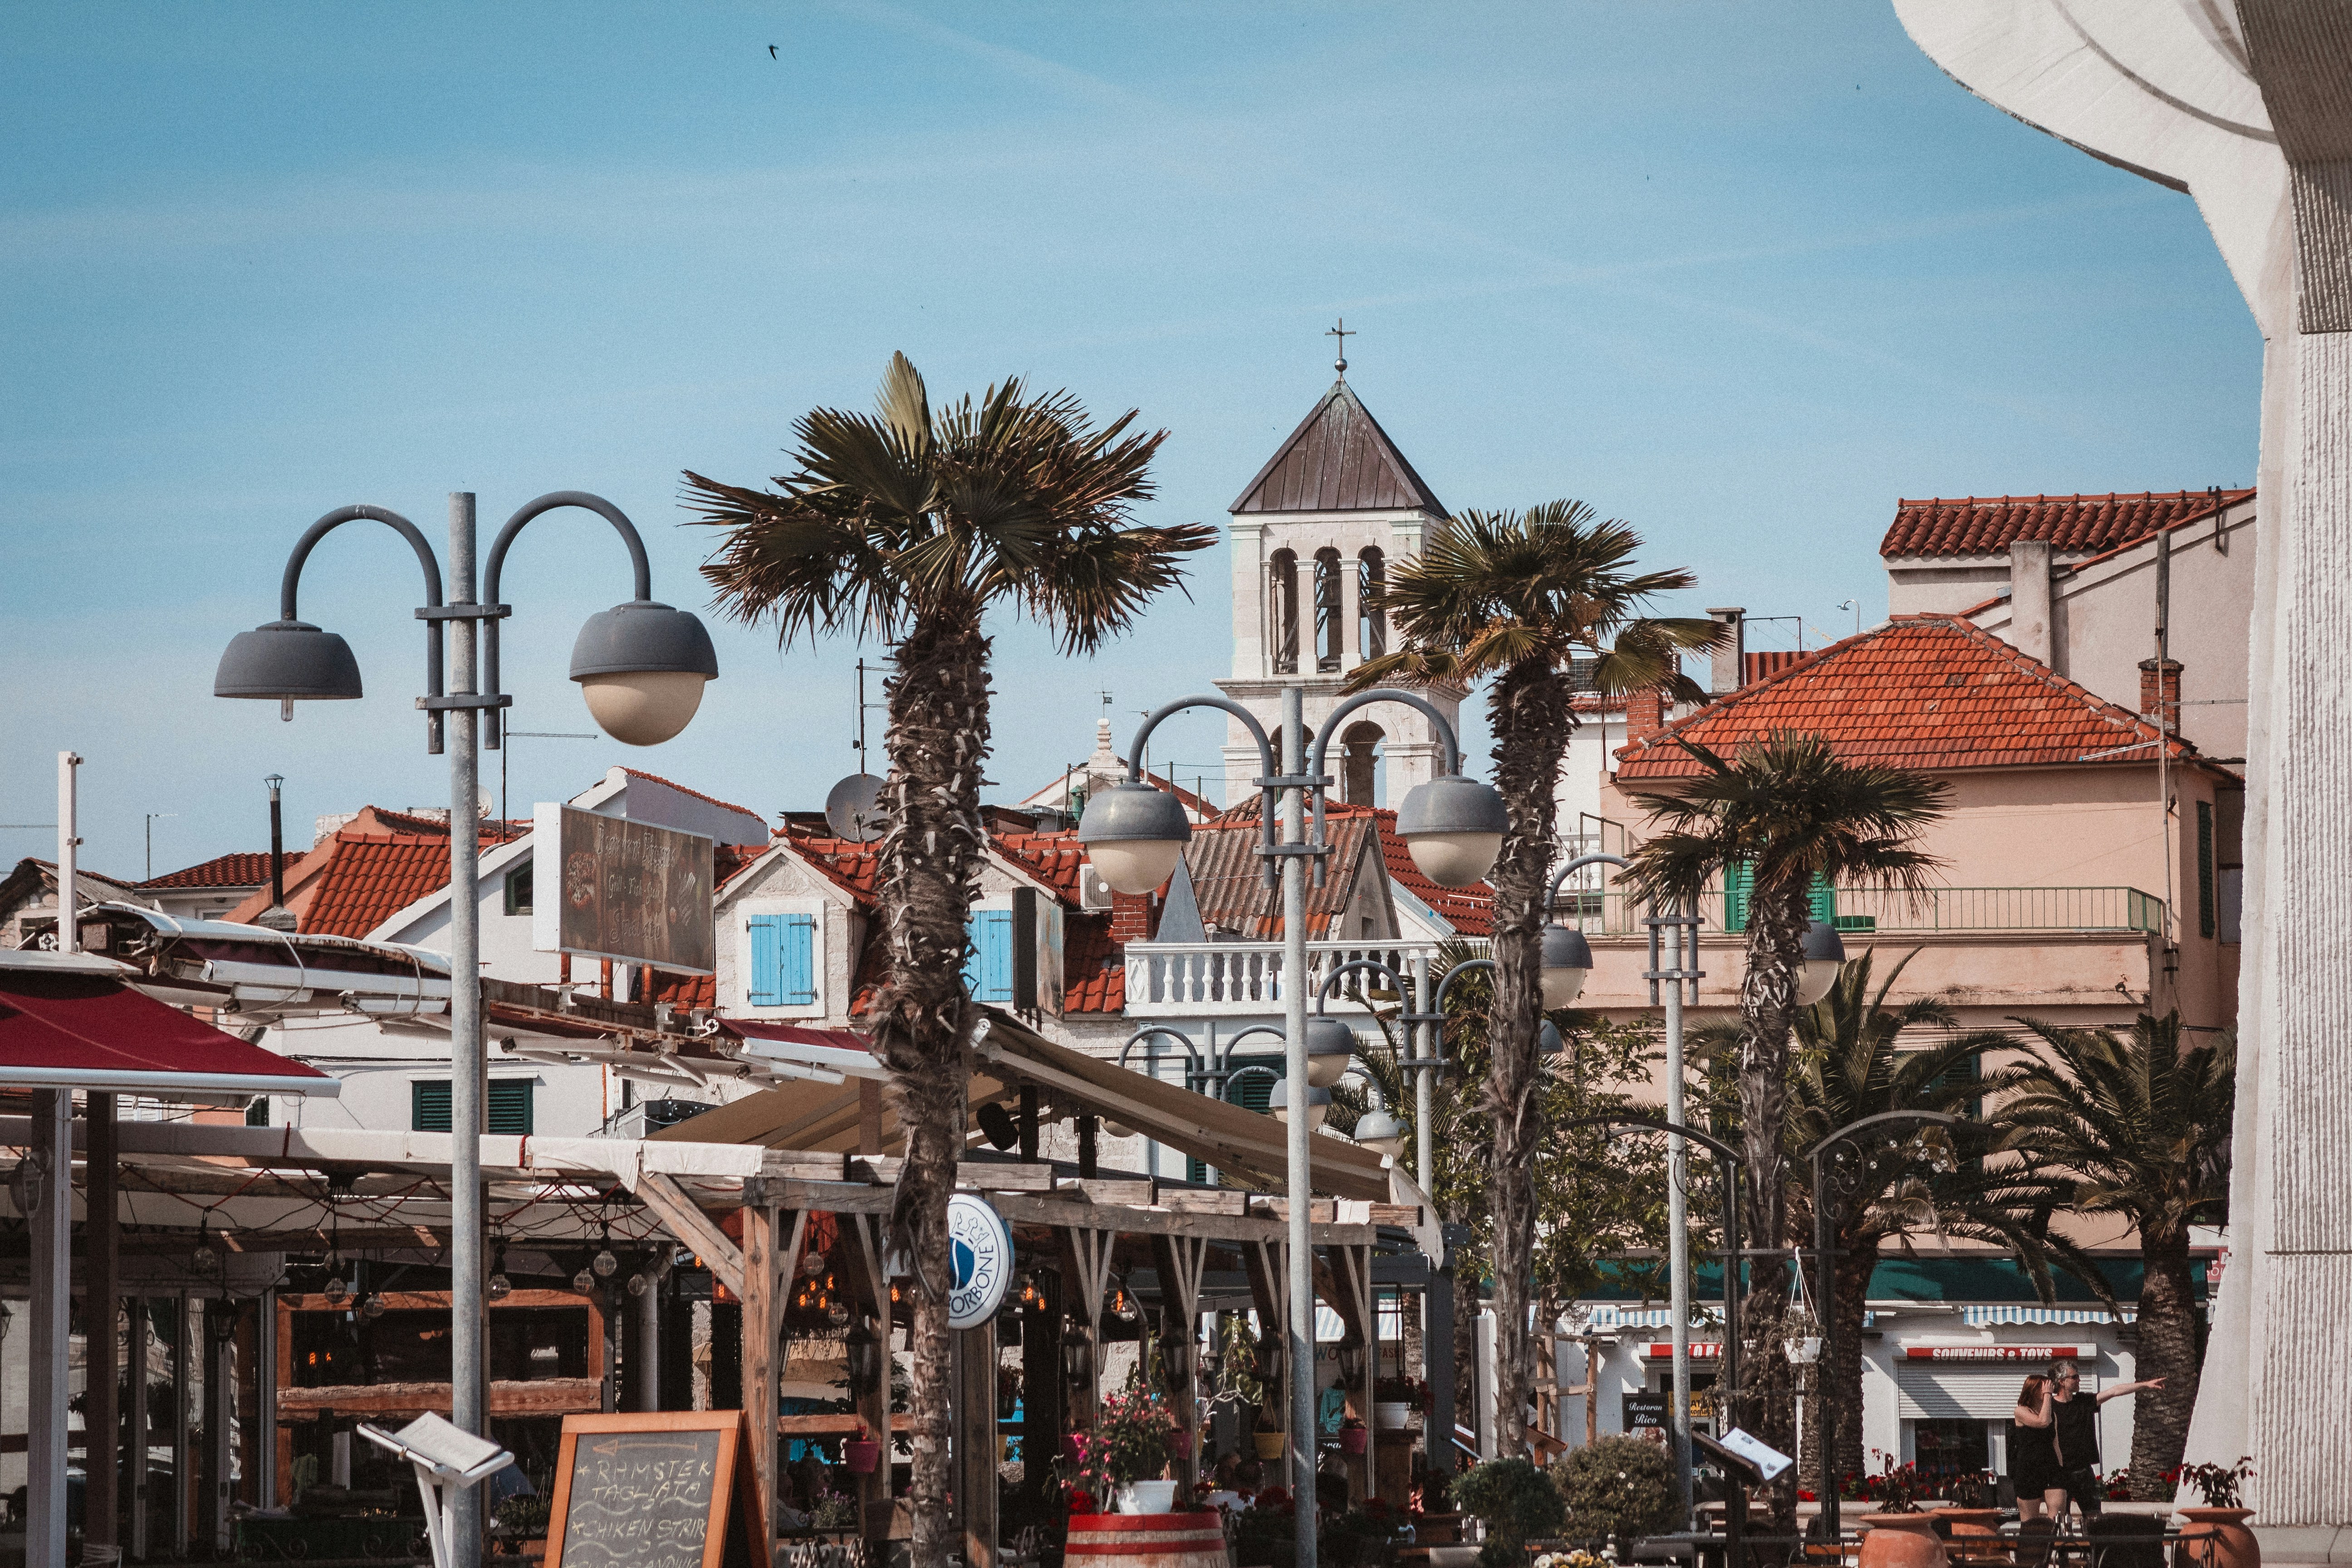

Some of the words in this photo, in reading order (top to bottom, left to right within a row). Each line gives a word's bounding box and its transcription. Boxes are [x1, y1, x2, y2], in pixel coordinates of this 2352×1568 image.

[608, 874, 622, 899] Grill
[949, 1245, 994, 1313] ORBONE
[1932, 1348, 2005, 1361] SOUVENIRS
[2020, 1348, 2053, 1360] TOYS
[1629, 1402, 1662, 1411] Restoran
[1635, 1413, 1656, 1424] Rico
[592, 1480, 701, 1501] TAGLIATA
[583, 1519, 653, 1539] CHIKEN
